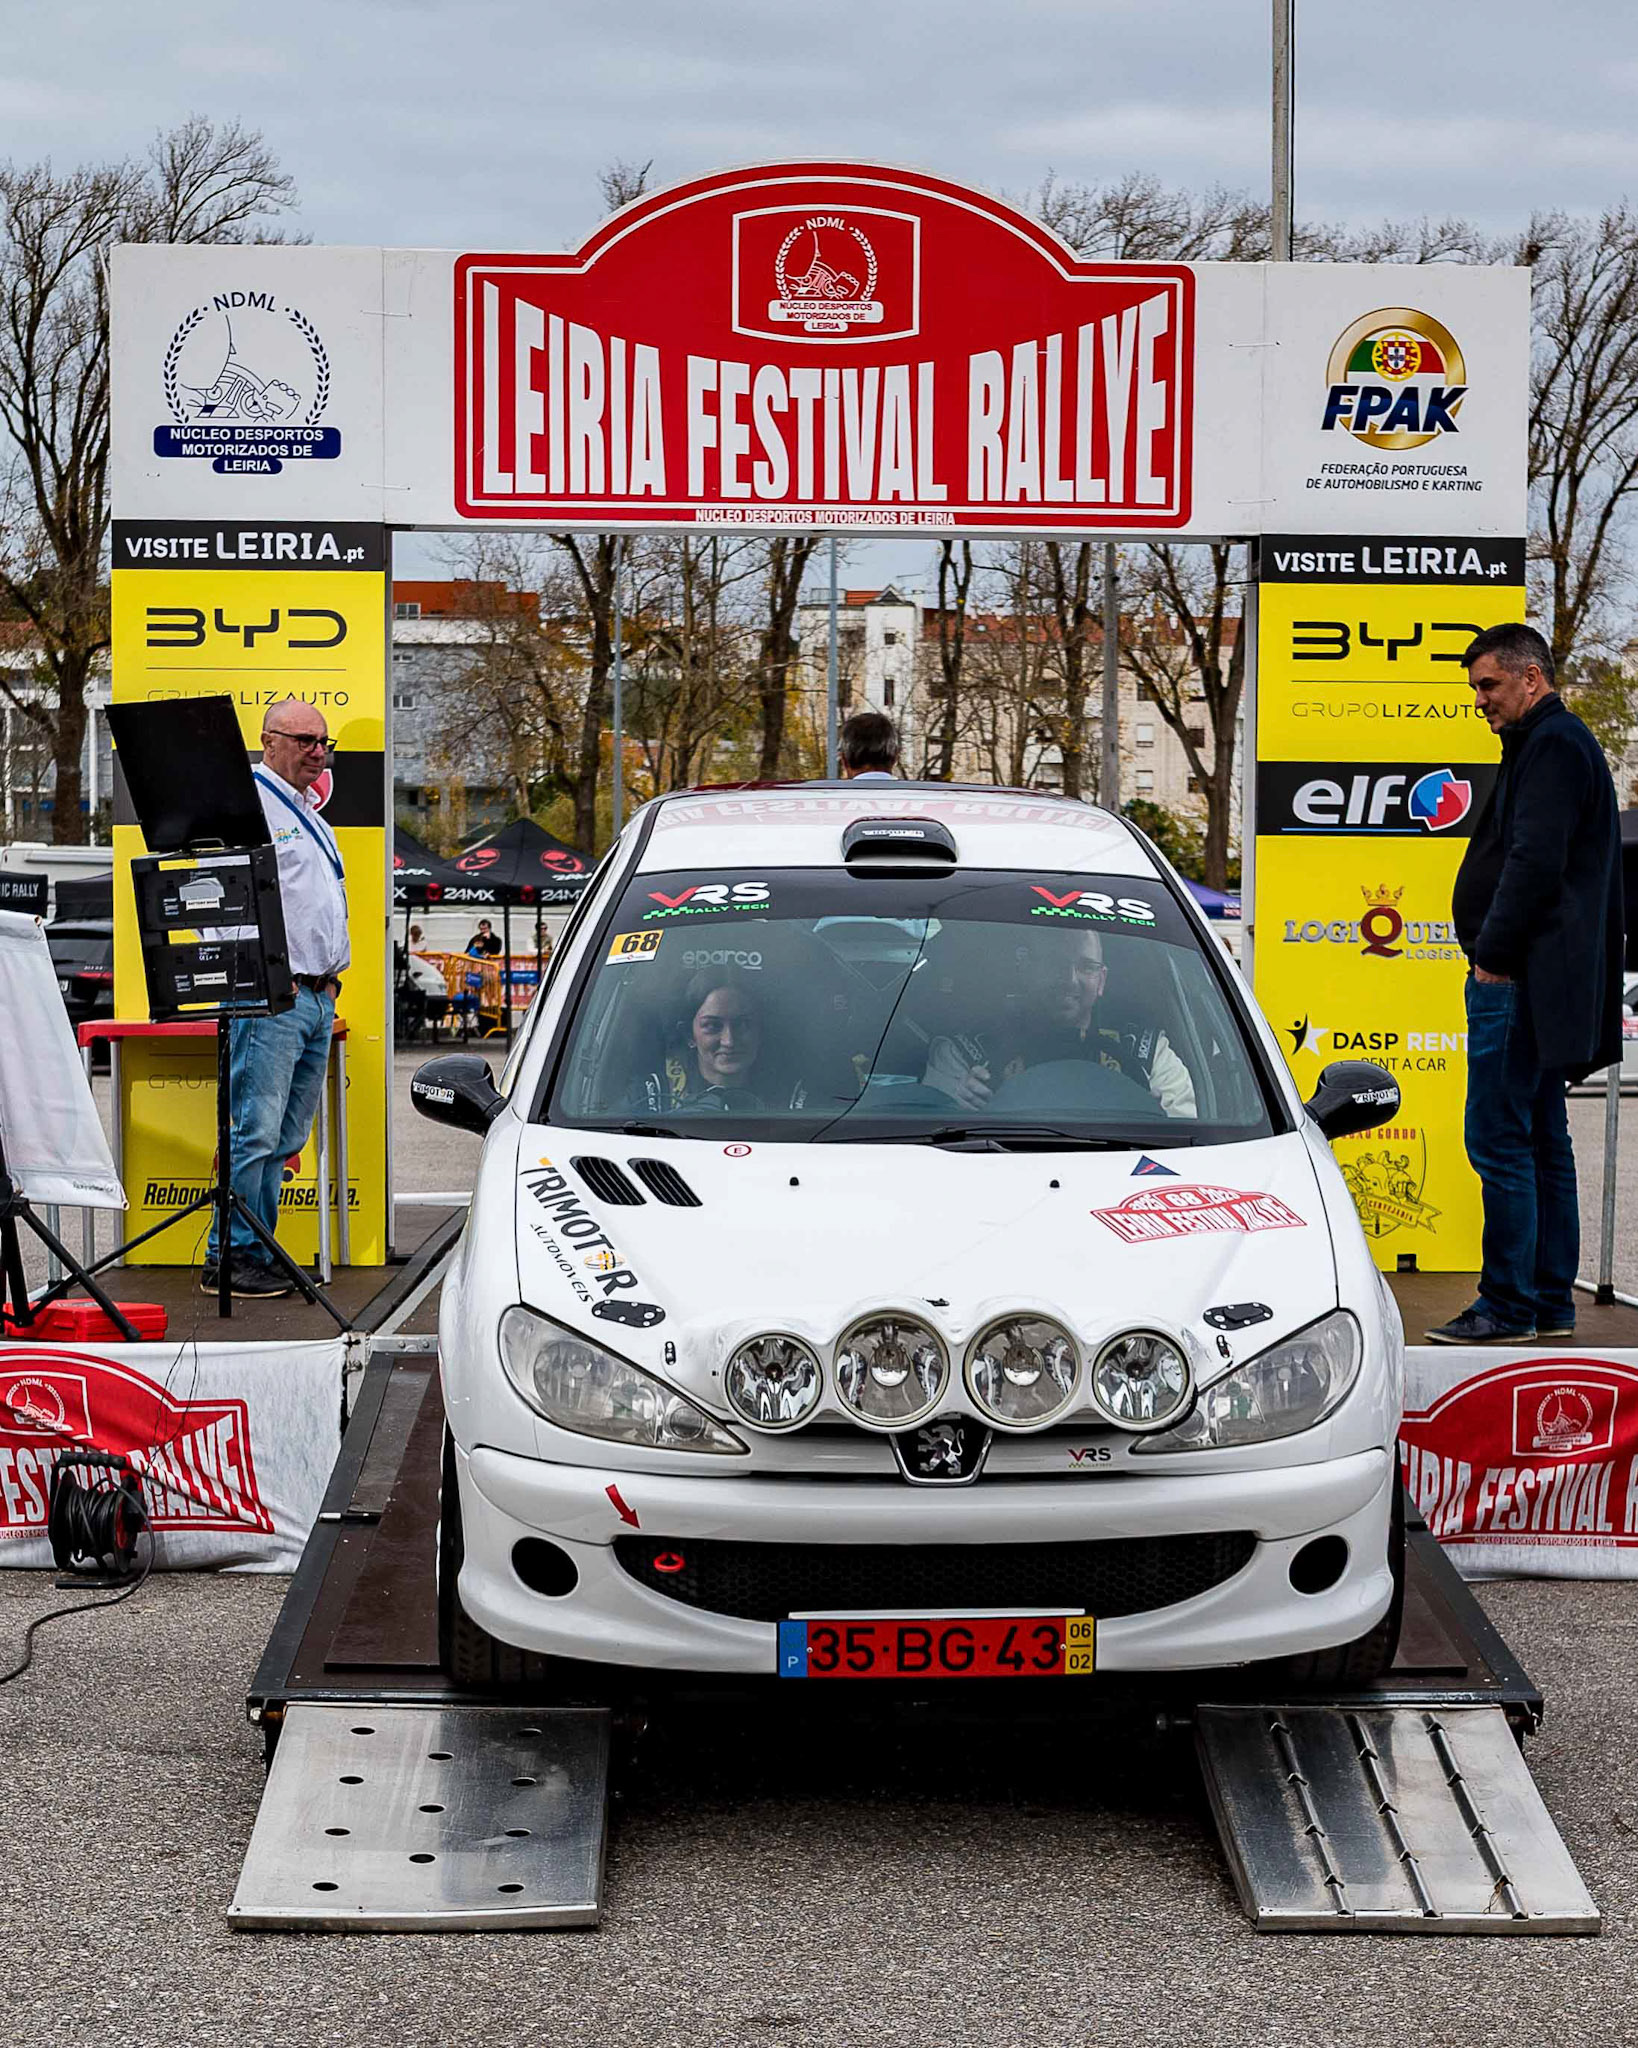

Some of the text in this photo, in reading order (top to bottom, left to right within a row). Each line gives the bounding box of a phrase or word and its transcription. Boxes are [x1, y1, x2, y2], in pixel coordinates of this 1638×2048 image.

[806, 217, 845, 230] NDML
[213, 291, 277, 312] NDML
[818, 302, 873, 311] DESPORTOS
[787, 311, 866, 321] MOTORIZADOS DE
[811, 322, 841, 330] LEIRIA
[483, 280, 1169, 504] LEIRIA FESTIVAL RALLYE
[1321, 385, 1469, 432] FPAK
[170, 426, 324, 441] NÚCLEO DESPORTOS
[182, 444, 312, 456] MOTORIZADOS DE
[224, 459, 271, 472] LEIRIA
[1321, 462, 1468, 477] FEDERAÇÃO PORTUGUESA
[1306, 479, 1483, 491] DE AUTOMOBILISMO E KARTING
[745, 510, 812, 523] DESPORTOS
[815, 511, 897, 524] MOTORIZADOS
[900, 512, 915, 524] DE
[917, 512, 956, 525] LEIRIA
[125, 537, 209, 559] VISITE
[1273, 552, 1355, 573] VISITE
[146, 607, 348, 648] BYD
[1292, 621, 1487, 661] BYD
[1291, 775, 1407, 825] elf
[13, 882, 39, 898] RALLY
[541, 888, 584, 901] 24M
[648, 881, 770, 908] VRS
[686, 903, 770, 914] RALLY TECH
[1030, 886, 1155, 920] VRS
[1073, 912, 1156, 927] RALLY TECH
[1283, 906, 1459, 959] LOGIQUE
[621, 932, 660, 953] 68
[682, 950, 763, 970] sparco
[1333, 1032, 1399, 1050] DASP
[1402, 1058, 1412, 1070] A
[1416, 1058, 1446, 1071] CAR
[1108, 1196, 1298, 1241] LEIRIA FESTIVAL RALLYE
[20, 1377, 43, 1387] NDML
[1554, 1387, 1577, 1397] NDML
[1067, 1448, 1111, 1461] VRS
[1399, 1439, 1472, 1536] IRIA
[1473, 1460, 1616, 1533] FESTIVAL
[0, 1529, 21, 1539] UCLEO
[1069, 1623, 1091, 1638] 06
[788, 1656, 798, 1668] P
[1069, 1654, 1090, 1669] 02
